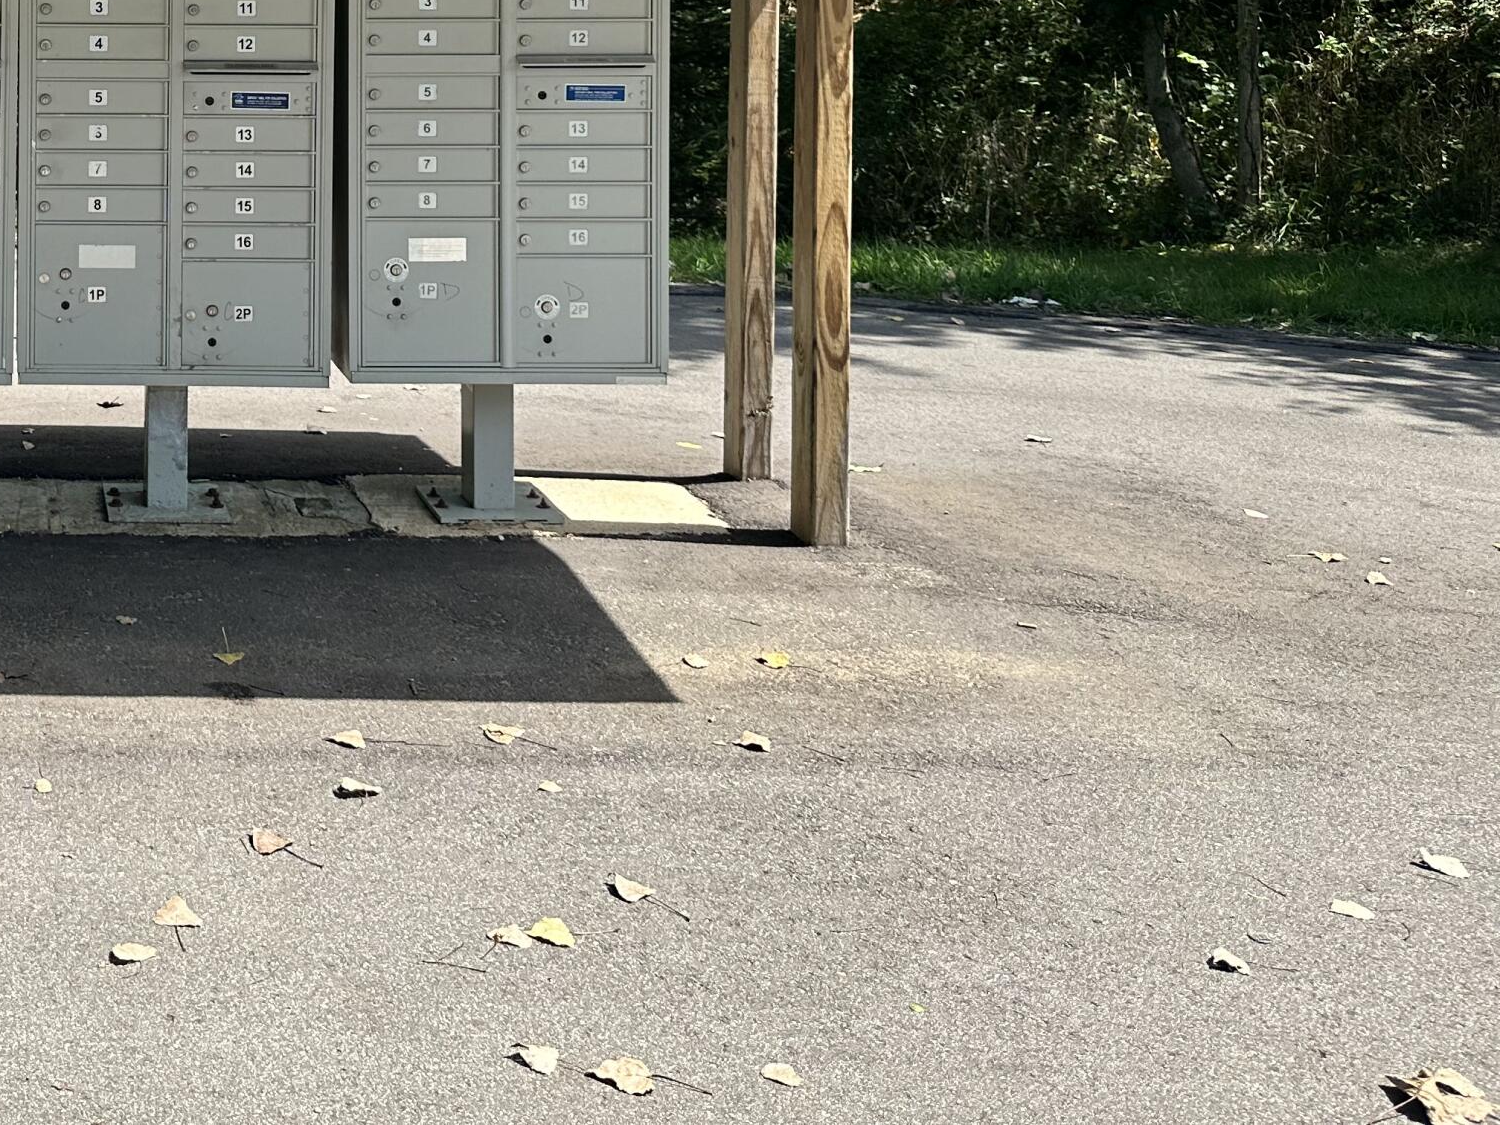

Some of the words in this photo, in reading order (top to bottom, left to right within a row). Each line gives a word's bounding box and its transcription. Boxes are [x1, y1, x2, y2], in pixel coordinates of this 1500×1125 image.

[95, 1, 104, 13] 3
[239, 2, 253, 15] 11
[94, 37, 104, 50] 4
[423, 32, 432, 43] 4
[571, 32, 586, 44] 12
[238, 38, 253, 50] 12
[94, 91, 103, 104] 5
[424, 86, 432, 98] 5
[423, 122, 431, 134] 6
[571, 122, 586, 134] 13
[237, 128, 253, 141] 13
[237, 164, 253, 176] 14
[423, 158, 431, 170] 7
[571, 159, 586, 170] 14
[93, 198, 102, 211] 8
[237, 200, 252, 212] 15
[423, 194, 431, 206] 8
[571, 195, 586, 207] 15
[236, 236, 252, 248] 16
[571, 231, 586, 243] 16
[89, 289, 105, 301] 1P
[420, 284, 436, 296] 1P
[235, 308, 252, 320] 2P
[571, 304, 588, 316] 2P
